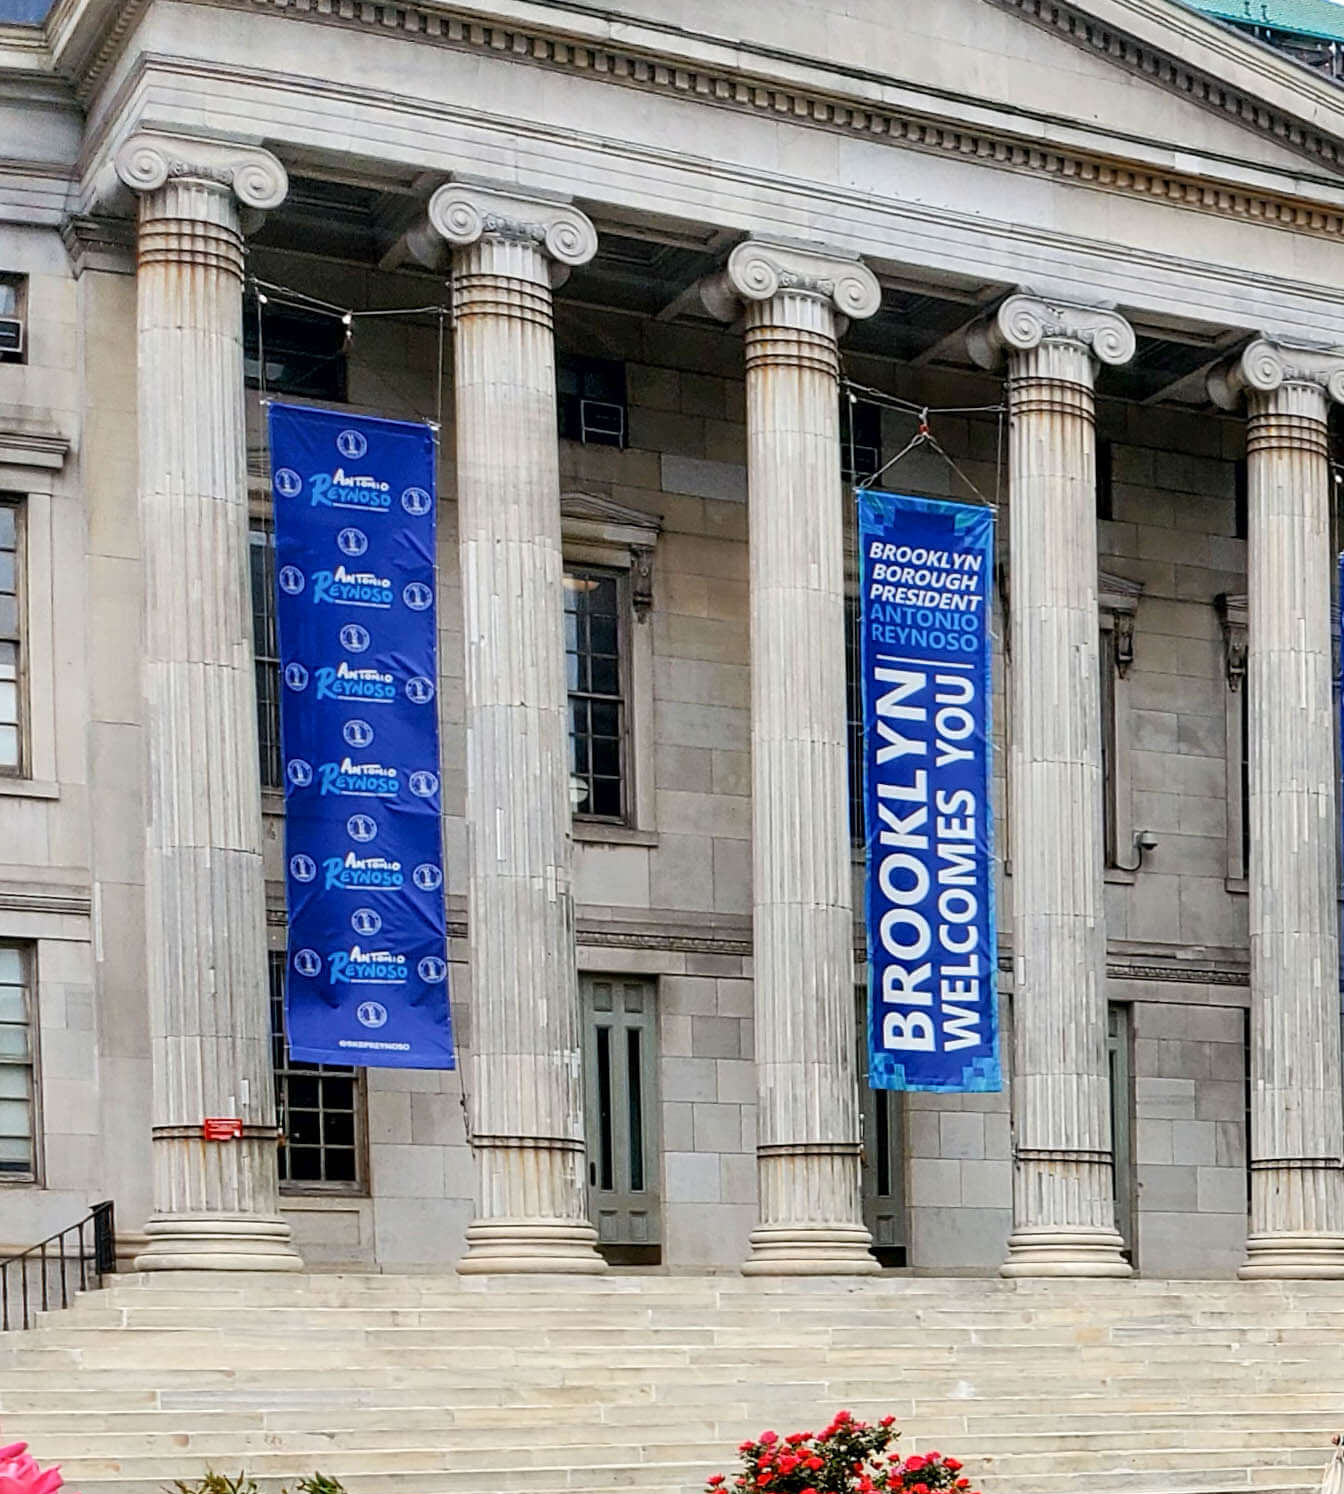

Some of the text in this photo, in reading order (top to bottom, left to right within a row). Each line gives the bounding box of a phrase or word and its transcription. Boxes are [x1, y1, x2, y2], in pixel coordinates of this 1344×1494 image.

[309, 473, 391, 508] REYNOSO
[870, 542, 982, 572] BROOKLYN
[312, 570, 393, 605] REYNOSO
[873, 564, 978, 591] BOROUGH
[870, 584, 982, 611] PRESIDENT
[870, 603, 978, 631] ANTONIO
[872, 623, 978, 651] REYNOSO
[315, 667, 396, 701] REYNOSO
[319, 763, 400, 796] REYNOSO
[323, 857, 404, 890] REYNOSO
[874, 667, 936, 1052] BROOKLYN
[935, 675, 982, 1052] WELCOMES YOU
[328, 952, 408, 984] REYNOSO
